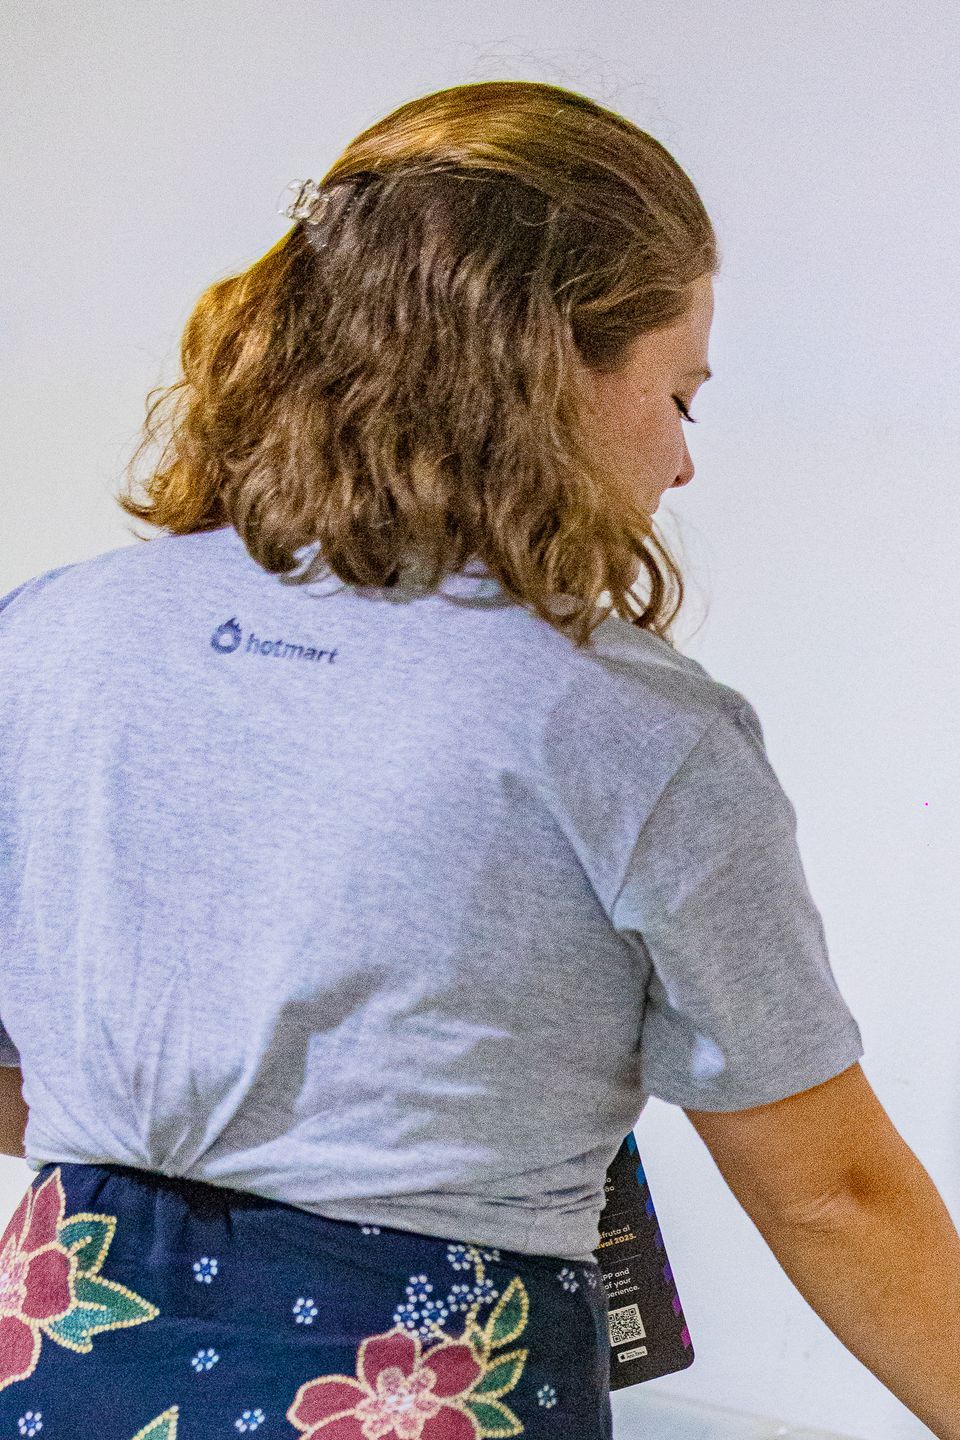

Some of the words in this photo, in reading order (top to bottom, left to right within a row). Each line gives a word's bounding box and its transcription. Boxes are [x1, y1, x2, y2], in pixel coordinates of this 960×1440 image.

[246, 633, 338, 664] hotmart
[614, 1267, 630, 1277] and
[604, 1281, 613, 1290] of
[613, 1278, 631, 1289] your
